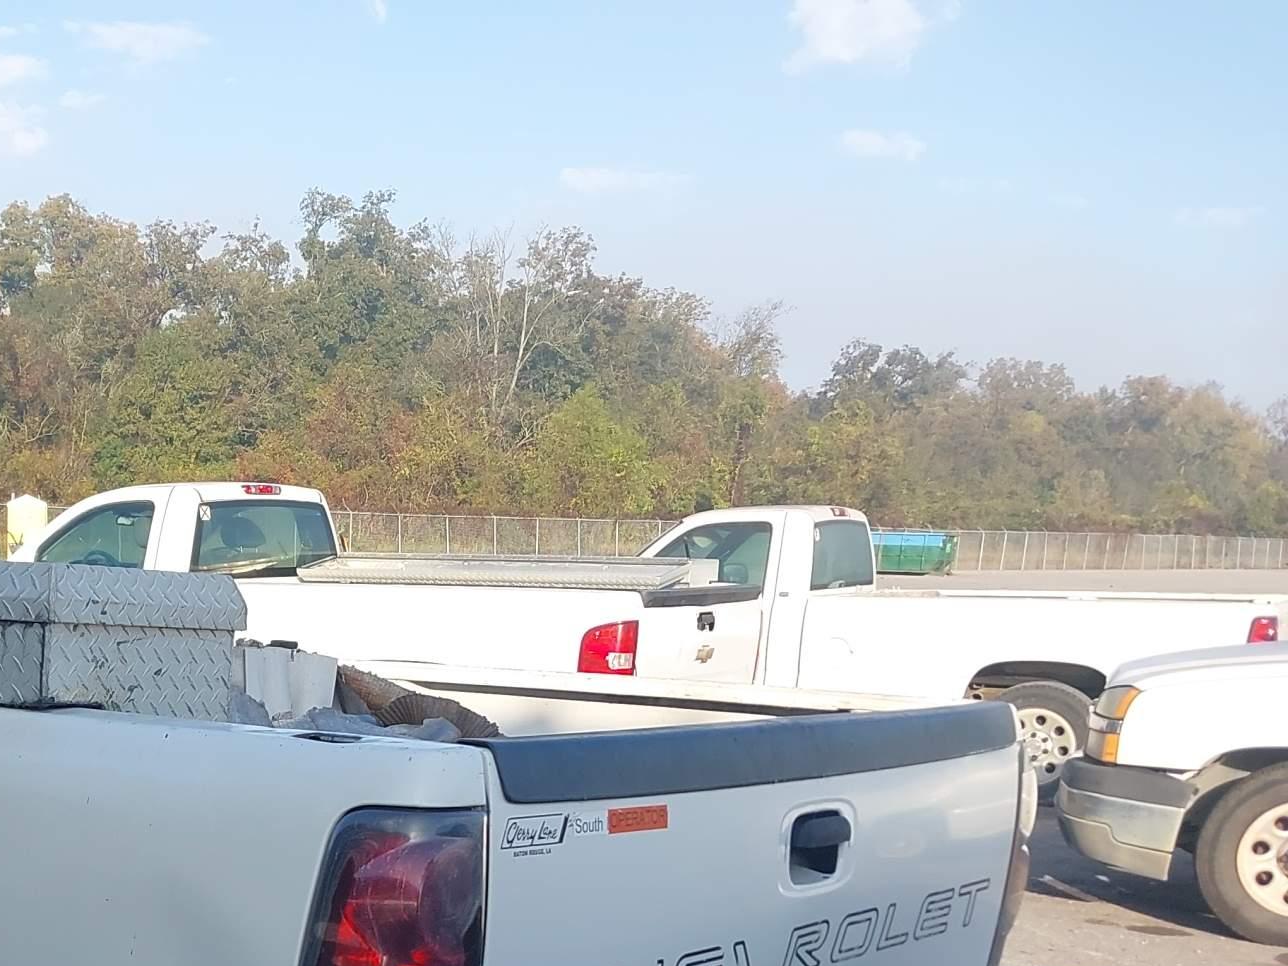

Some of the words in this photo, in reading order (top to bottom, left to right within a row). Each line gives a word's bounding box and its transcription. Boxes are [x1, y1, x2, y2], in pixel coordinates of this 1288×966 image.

[538, 820, 558, 840] Lane
[575, 817, 603, 834] South
[611, 809, 665, 828] OPERATOR
